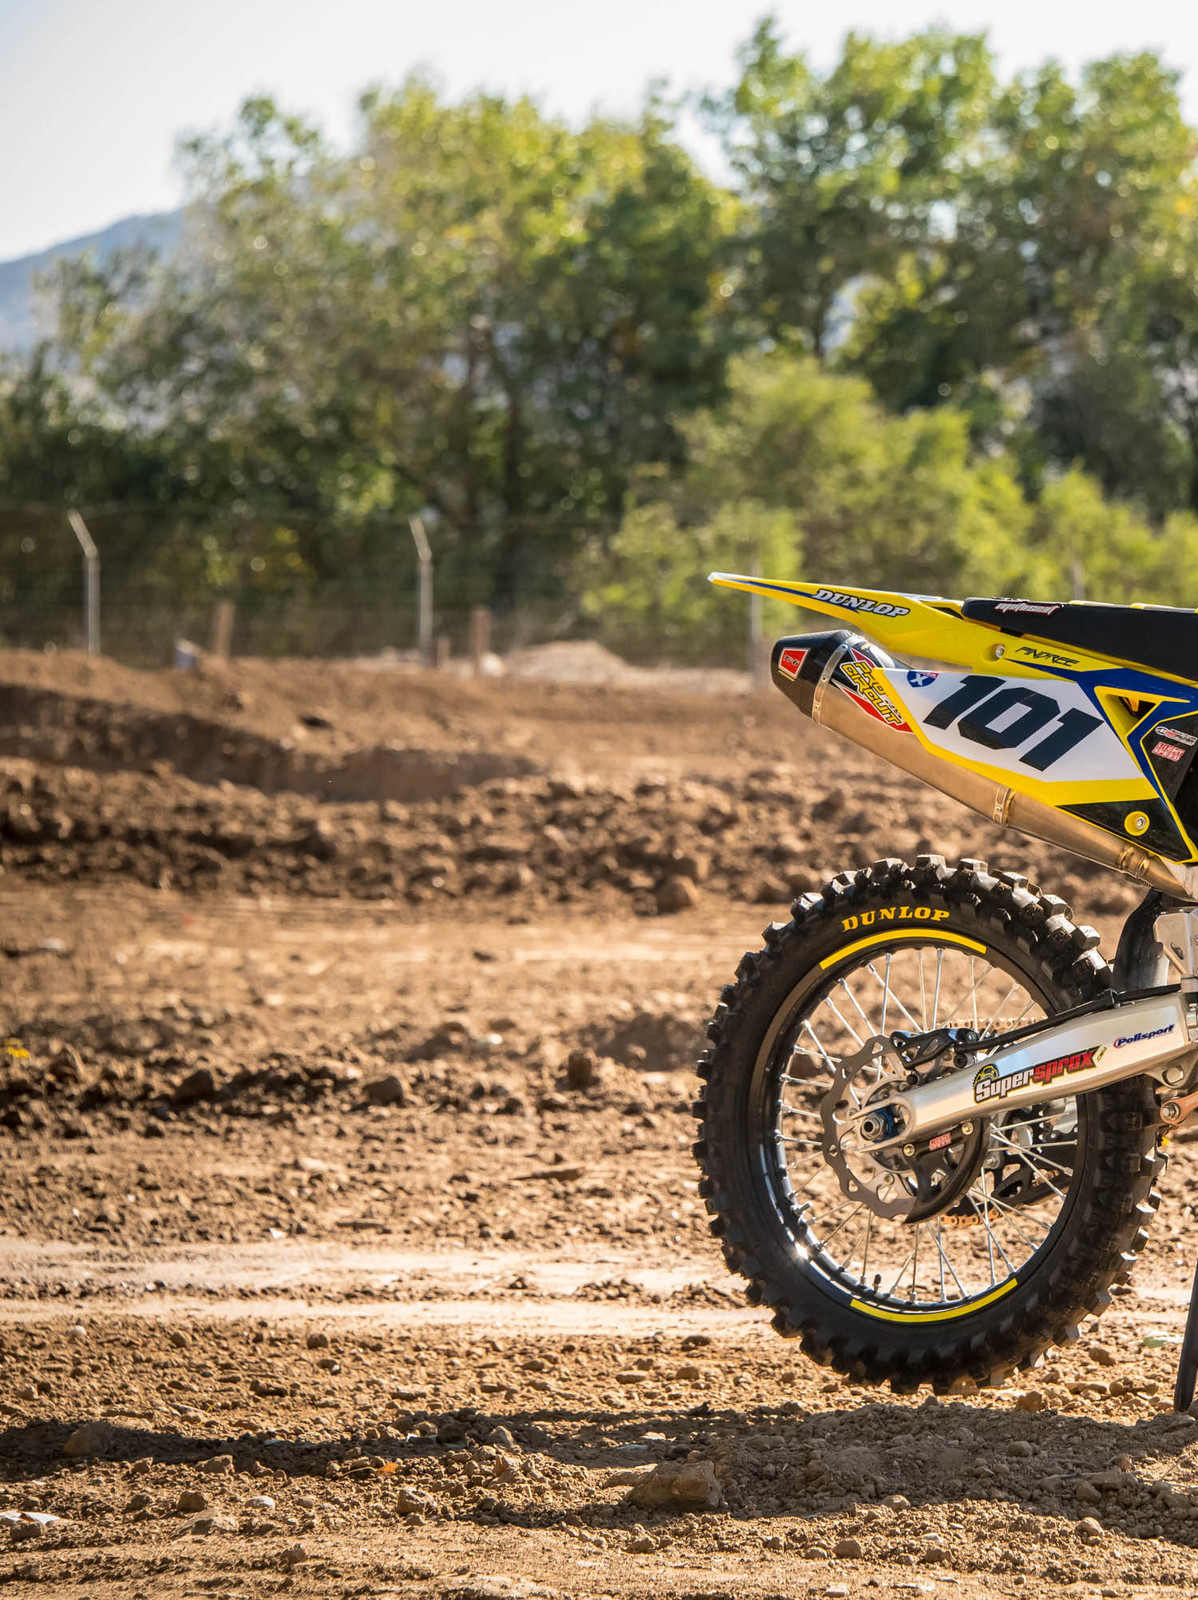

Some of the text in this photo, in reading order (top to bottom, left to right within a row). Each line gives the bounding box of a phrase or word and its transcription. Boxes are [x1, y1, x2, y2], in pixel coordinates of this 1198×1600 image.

[812, 588, 911, 617] DUNLOP
[841, 663, 902, 725] CIRCUIT
[923, 675, 1105, 772] 101
[841, 906, 950, 933] DUNLOP
[1116, 1024, 1175, 1047] Polisport
[975, 1050, 1095, 1103] Supersprox
